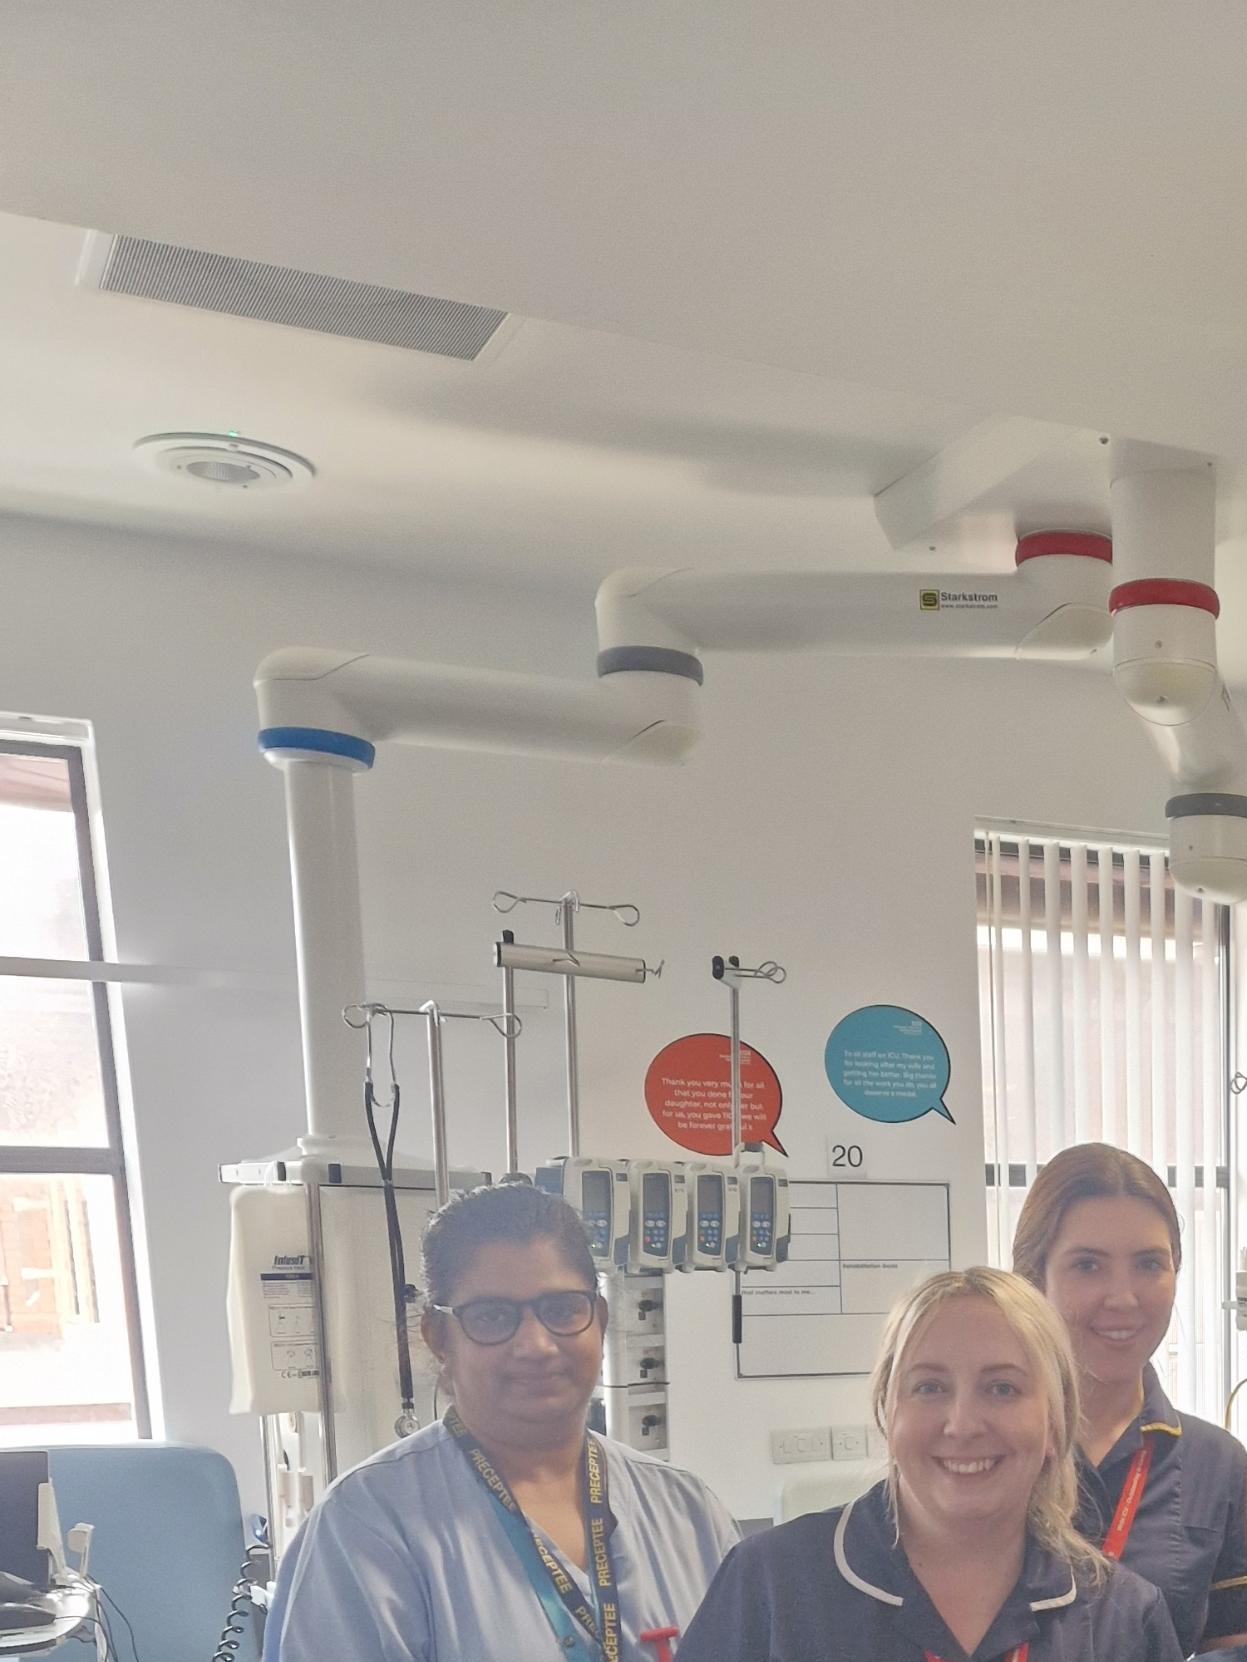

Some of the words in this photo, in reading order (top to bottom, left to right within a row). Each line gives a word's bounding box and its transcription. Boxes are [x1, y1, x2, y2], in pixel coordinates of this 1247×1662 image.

[941, 592, 998, 601] Starkstrom
[662, 1078, 685, 1086] Thank
[674, 1088, 690, 1096] that
[708, 1090, 727, 1098] done
[754, 1112, 767, 1120] will
[690, 1122, 716, 1130] forever
[832, 1145, 863, 1167] 20
[592, 1518, 610, 1587] PRECEPTEE
